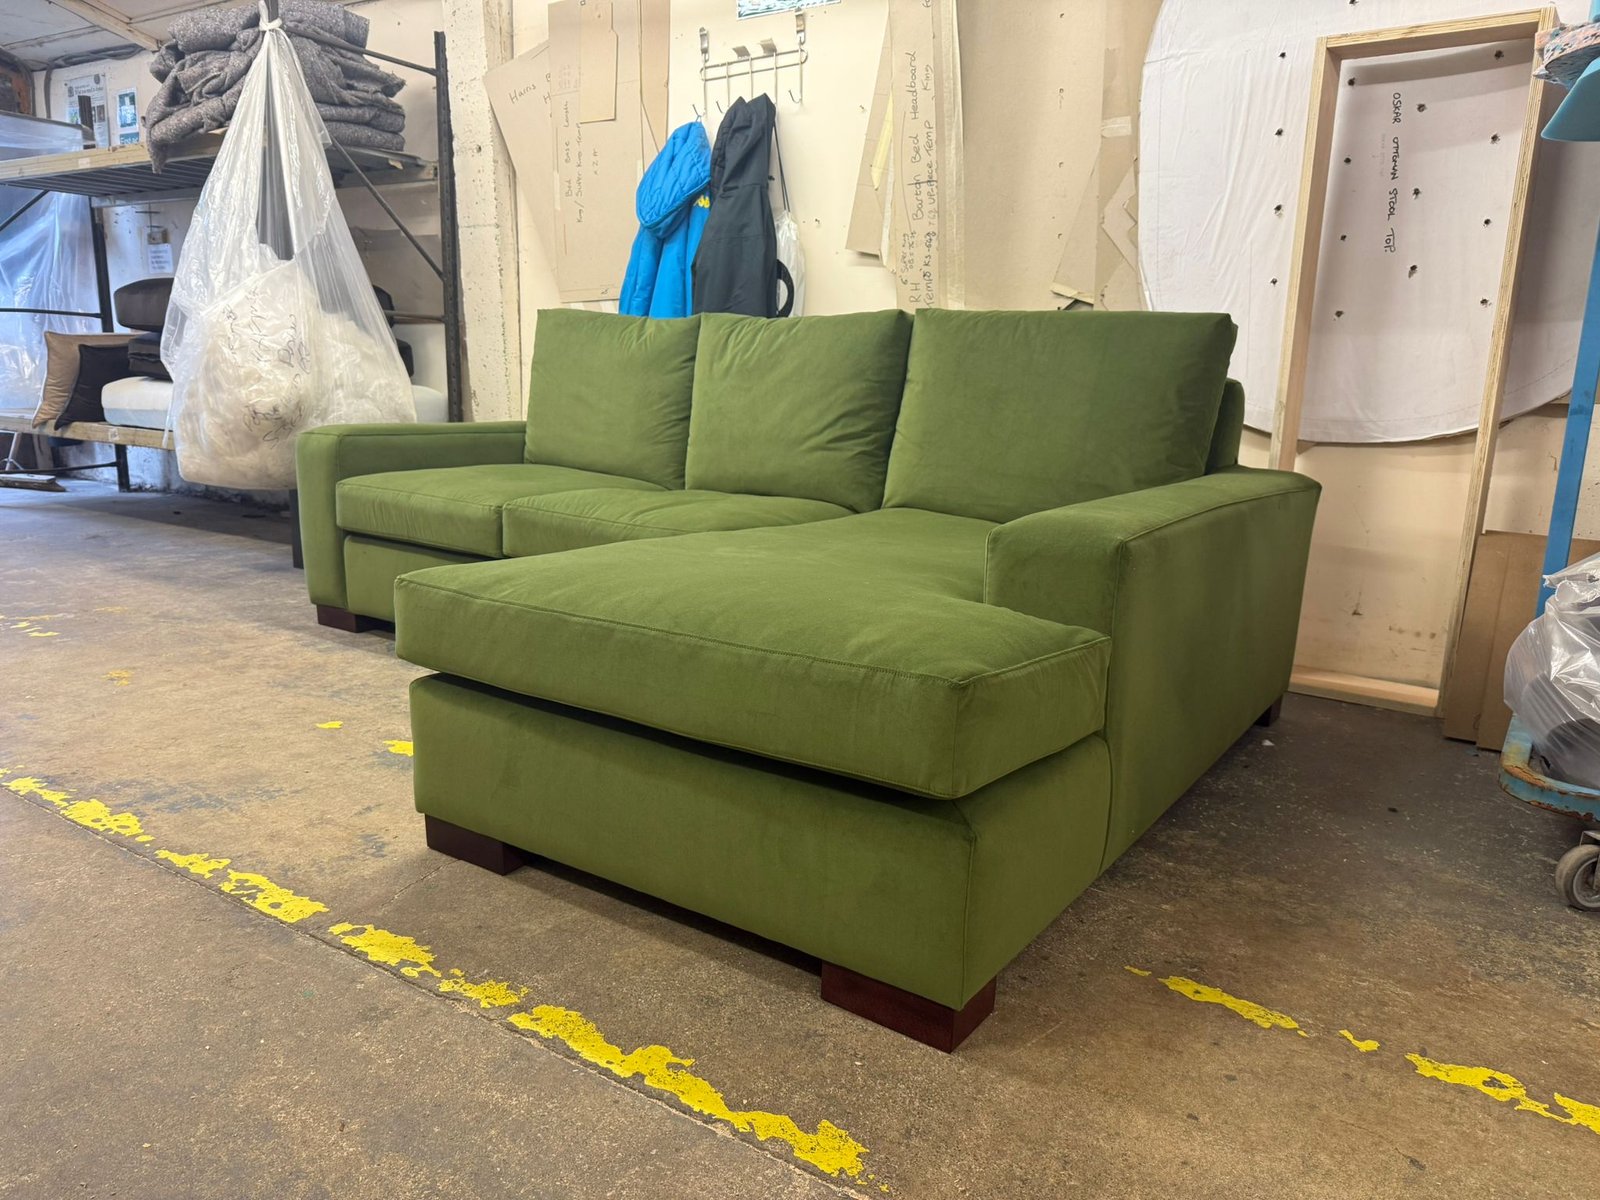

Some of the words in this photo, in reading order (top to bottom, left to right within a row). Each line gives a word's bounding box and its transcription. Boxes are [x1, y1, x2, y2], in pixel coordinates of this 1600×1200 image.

[508, 83, 537, 105] Harris
[905, 50, 919, 120] Headboard
[921, 64, 933, 91] King
[1391, 92, 1402, 125] OSKAR
[908, 134, 921, 164] Bed
[922, 120, 934, 156] Temp
[1390, 136, 1400, 181] OTTOMAN
[1387, 188, 1399, 221] STOOL
